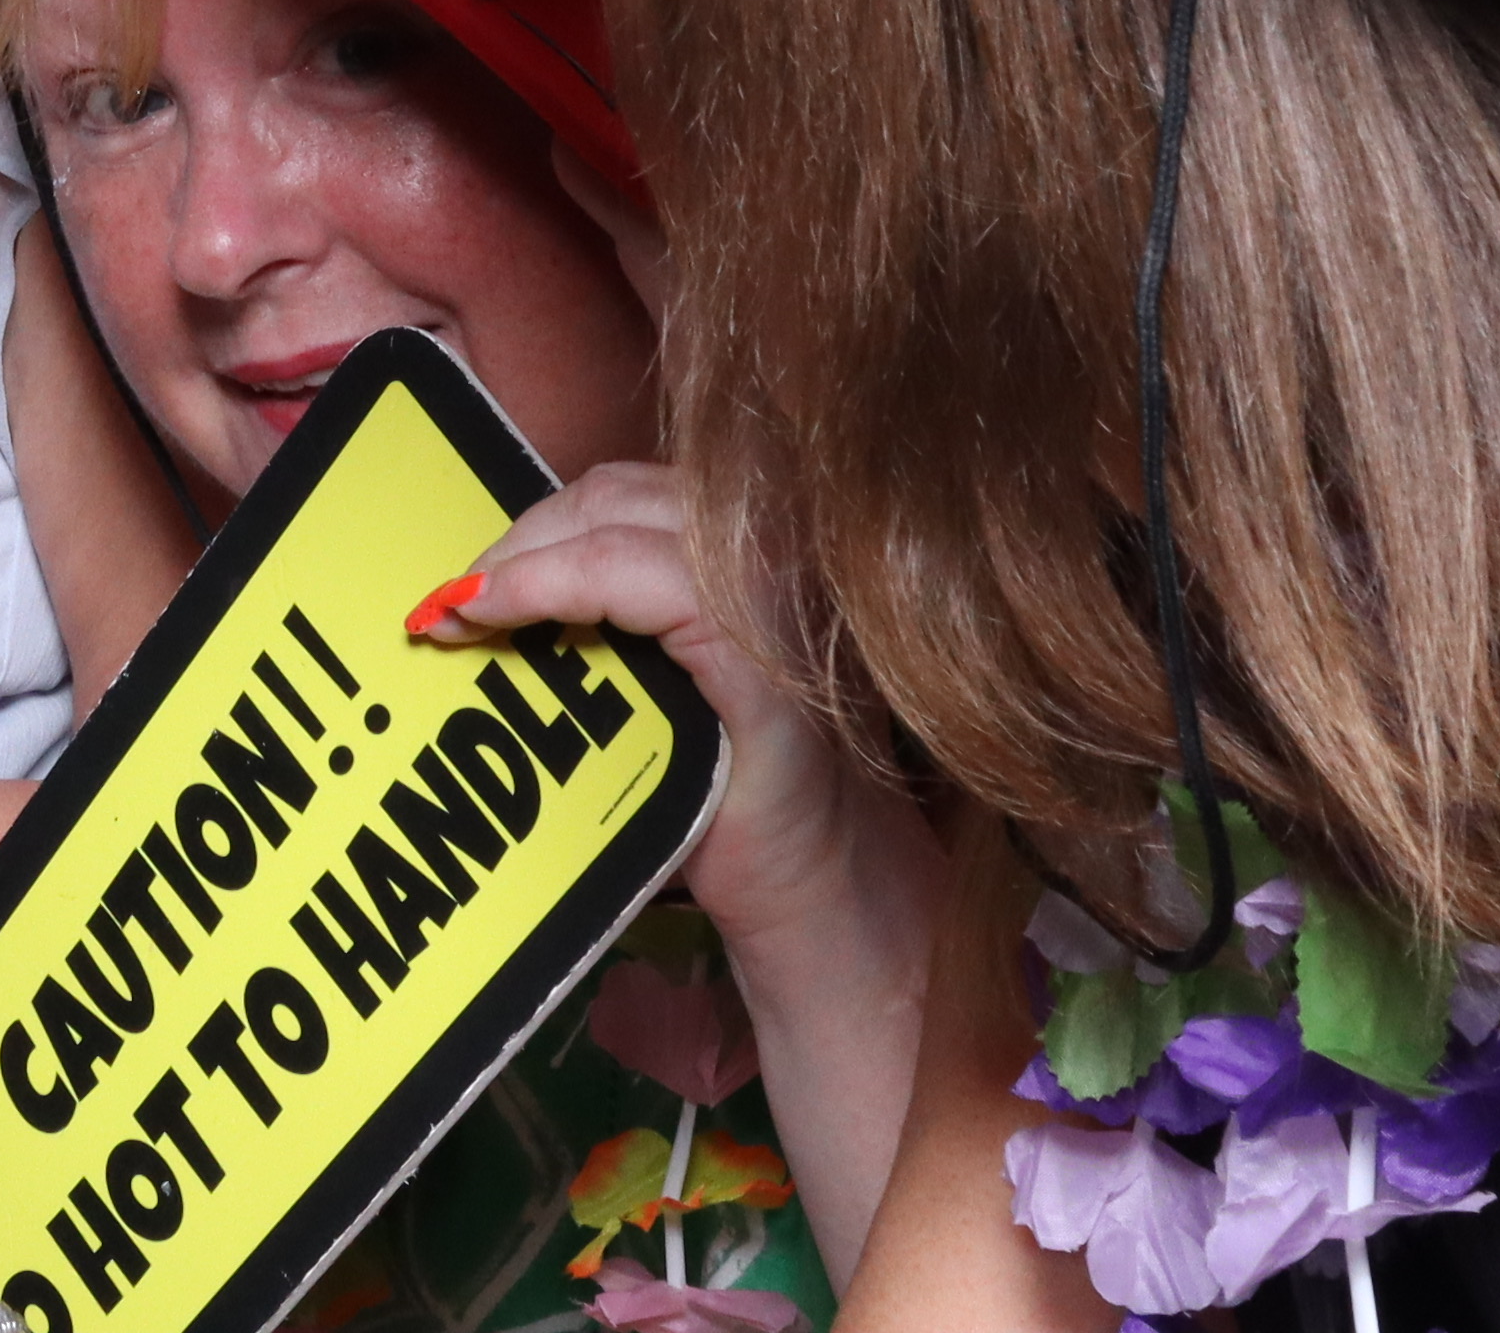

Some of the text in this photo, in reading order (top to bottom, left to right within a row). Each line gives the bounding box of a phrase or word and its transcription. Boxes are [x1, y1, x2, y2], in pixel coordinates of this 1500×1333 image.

[0, 604, 391, 1134] CAUTION!!
[46, 620, 635, 1315] HOT TO HANDLE
